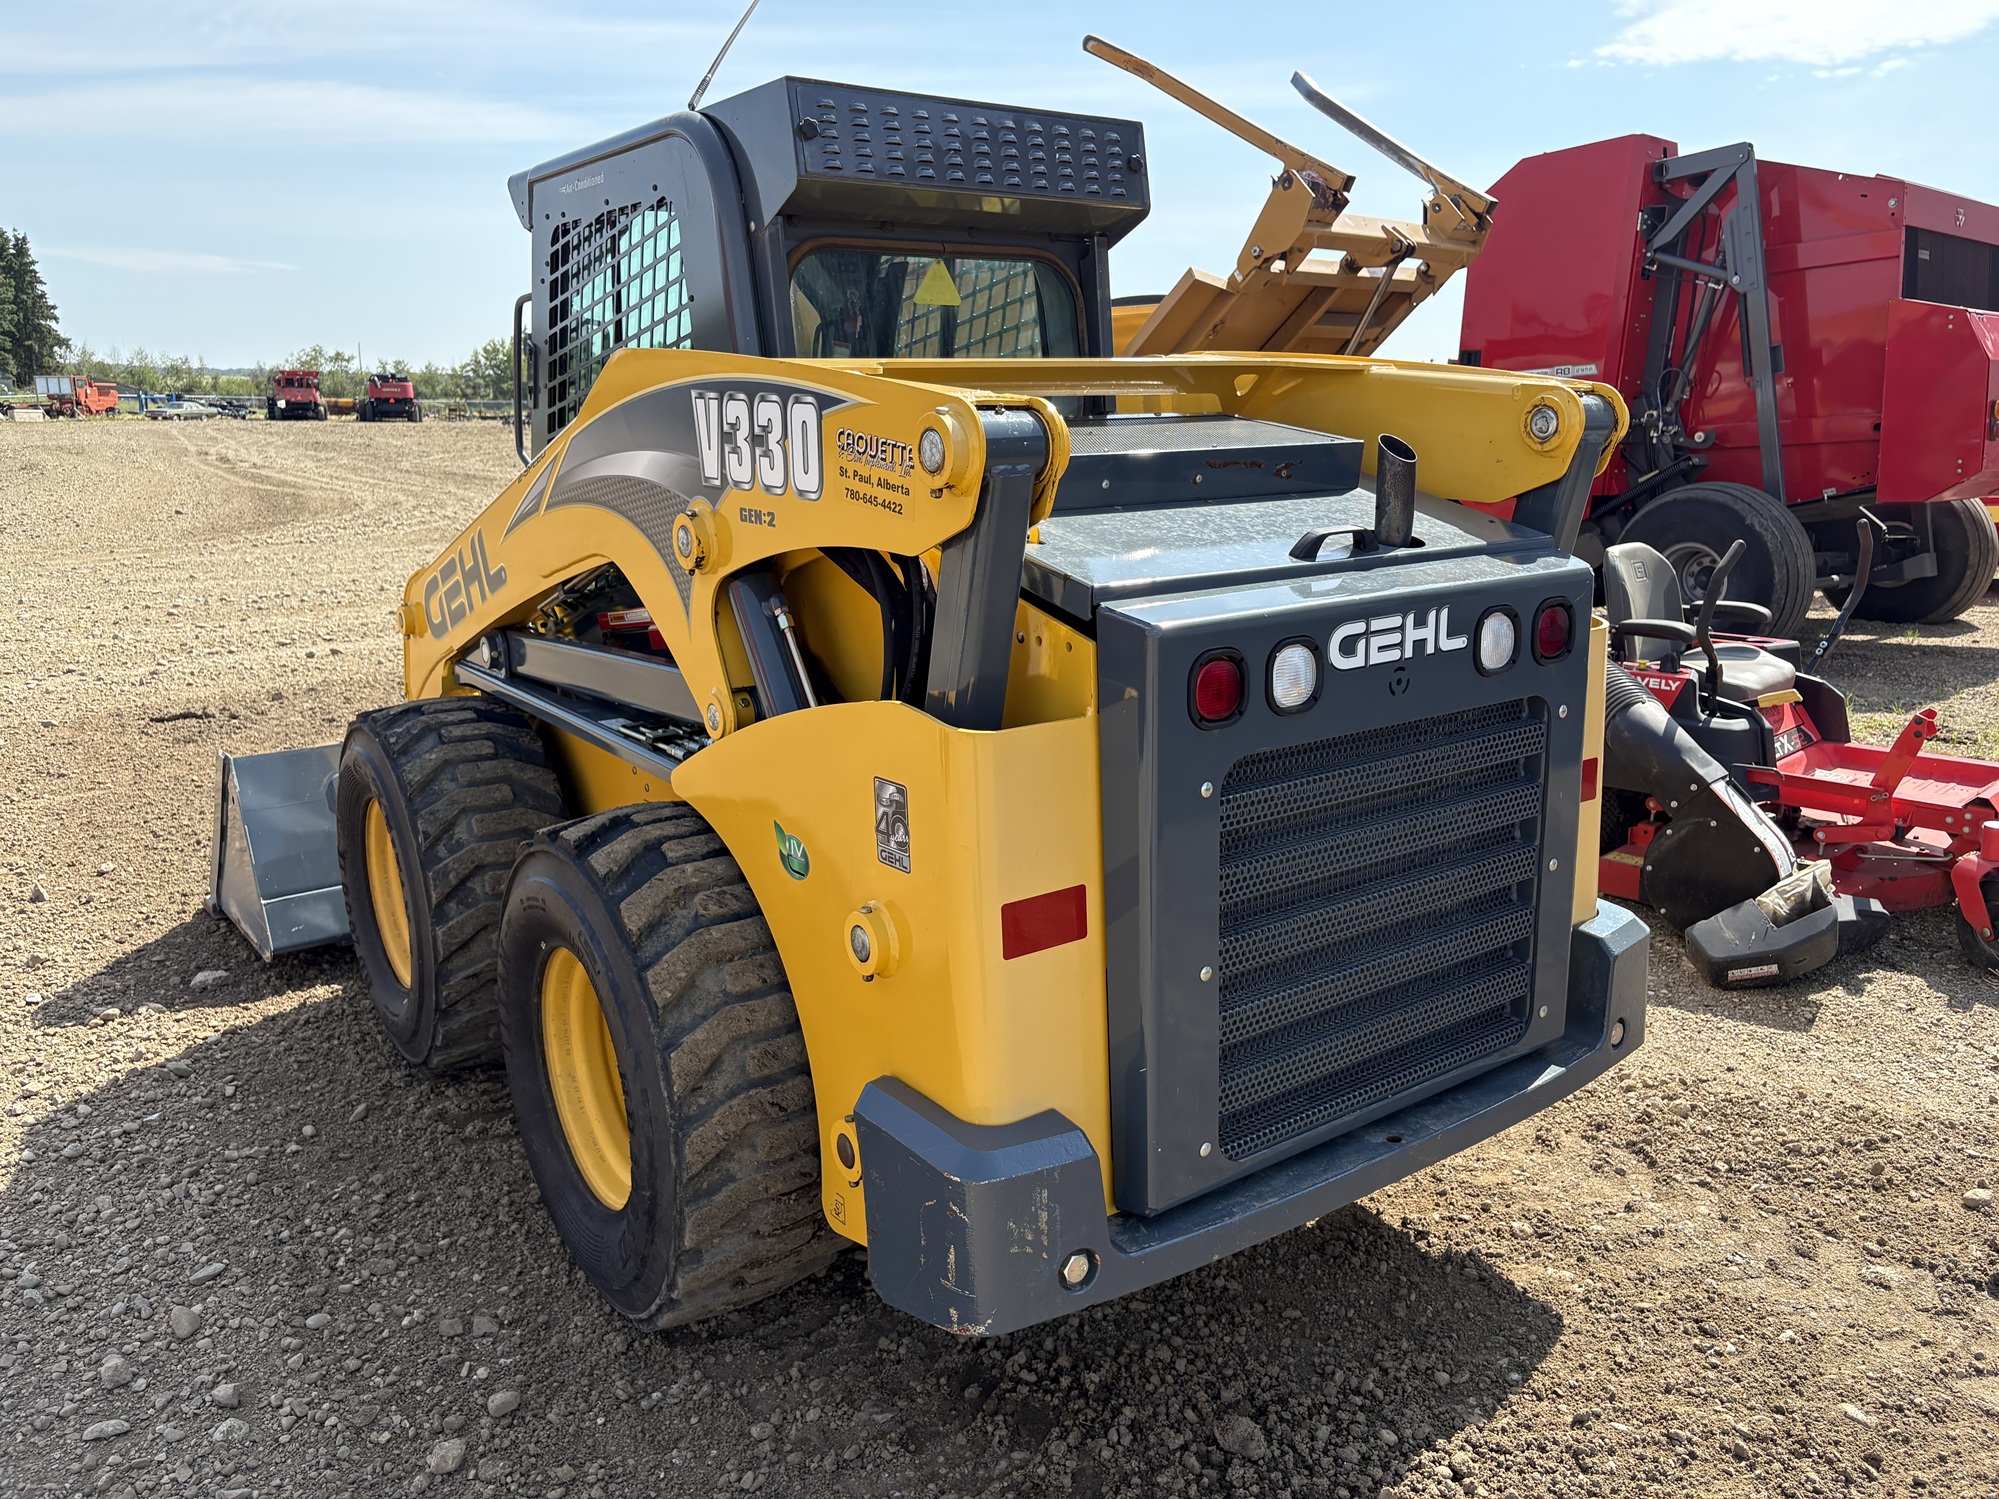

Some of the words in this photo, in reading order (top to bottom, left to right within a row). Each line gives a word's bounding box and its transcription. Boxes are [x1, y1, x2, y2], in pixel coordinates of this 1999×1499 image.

[1555, 367, 1571, 376] RB
[691, 389, 823, 501] V330
[839, 466, 851, 480] St.
[853, 469, 874, 488] Paul,
[877, 476, 911, 497] Alberta
[844, 487, 903, 515] 780-645-4422
[739, 506, 776, 528] GEN:2
[423, 525, 507, 640] GEHL
[1328, 604, 1469, 671] GEHL
[1633, 675, 1681, 691] VELY
[880, 849, 909, 871] GEHL
